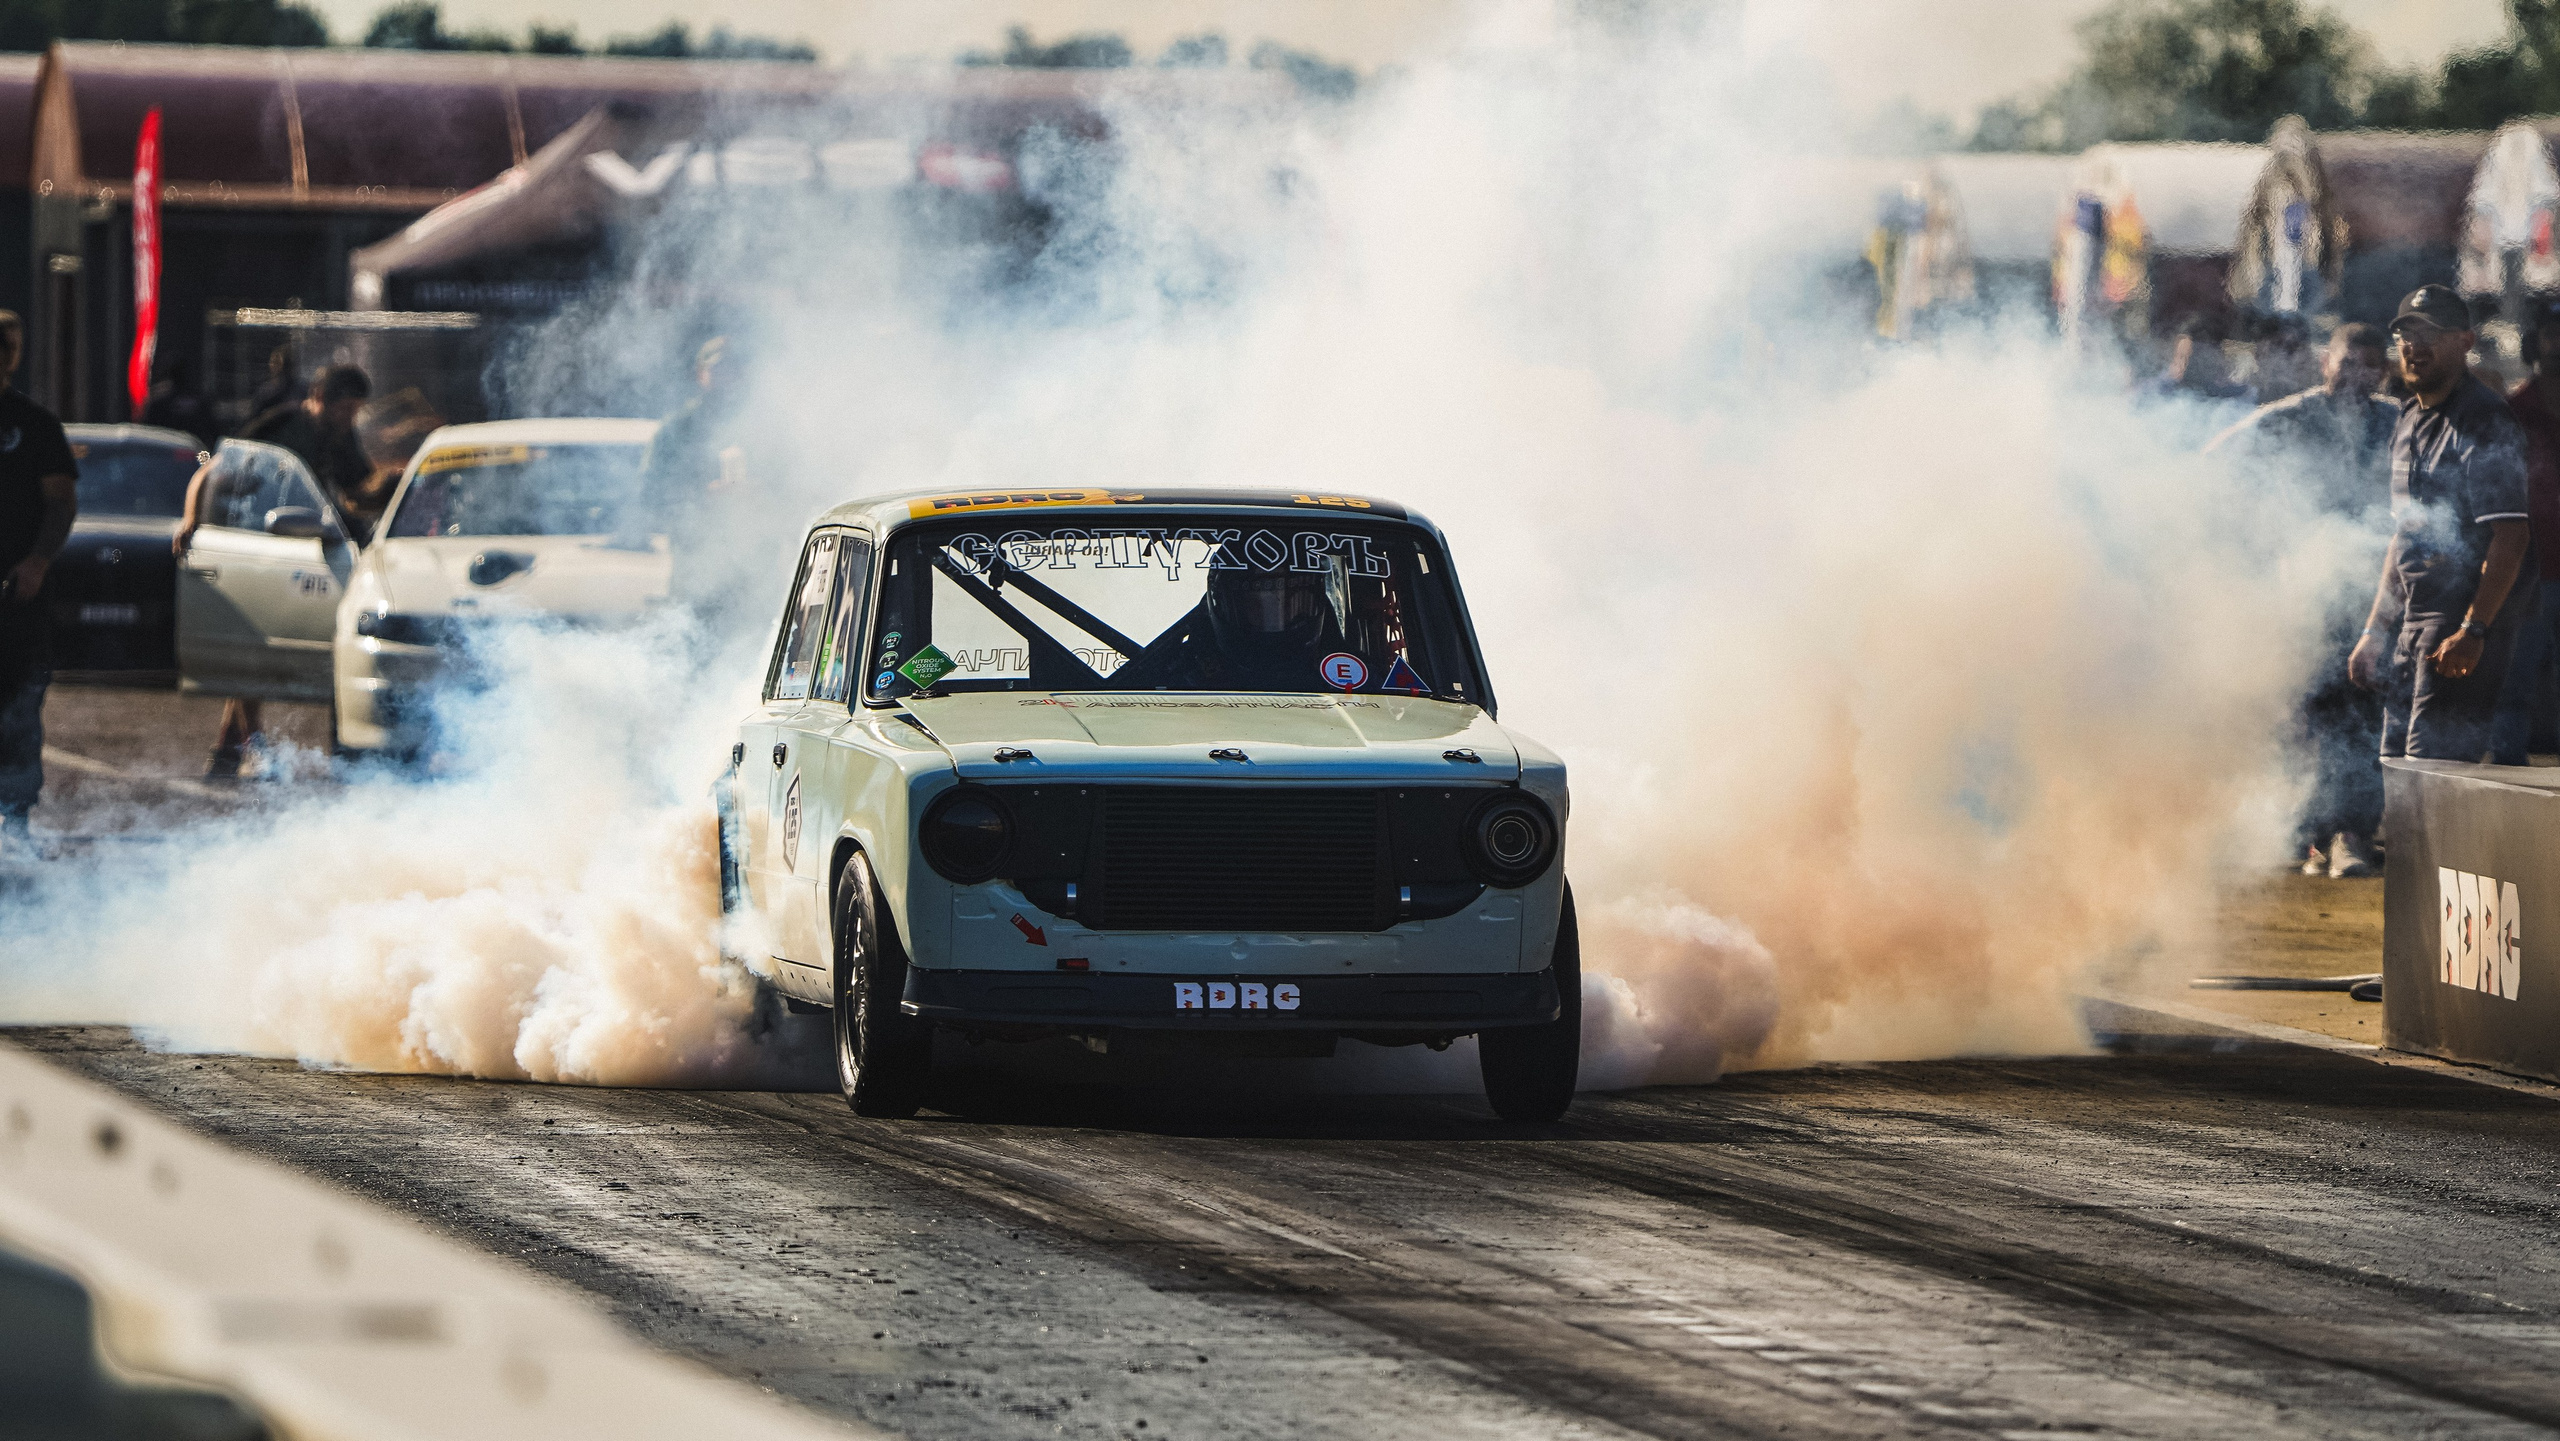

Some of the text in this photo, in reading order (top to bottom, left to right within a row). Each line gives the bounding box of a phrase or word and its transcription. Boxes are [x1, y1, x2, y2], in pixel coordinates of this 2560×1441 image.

[932, 493, 1085, 509] RDRC
[1291, 494, 1371, 508] 125
[1336, 663, 1352, 679] E
[2439, 866, 2521, 1001] RDRC
[1173, 982, 1301, 1010] RDRC
